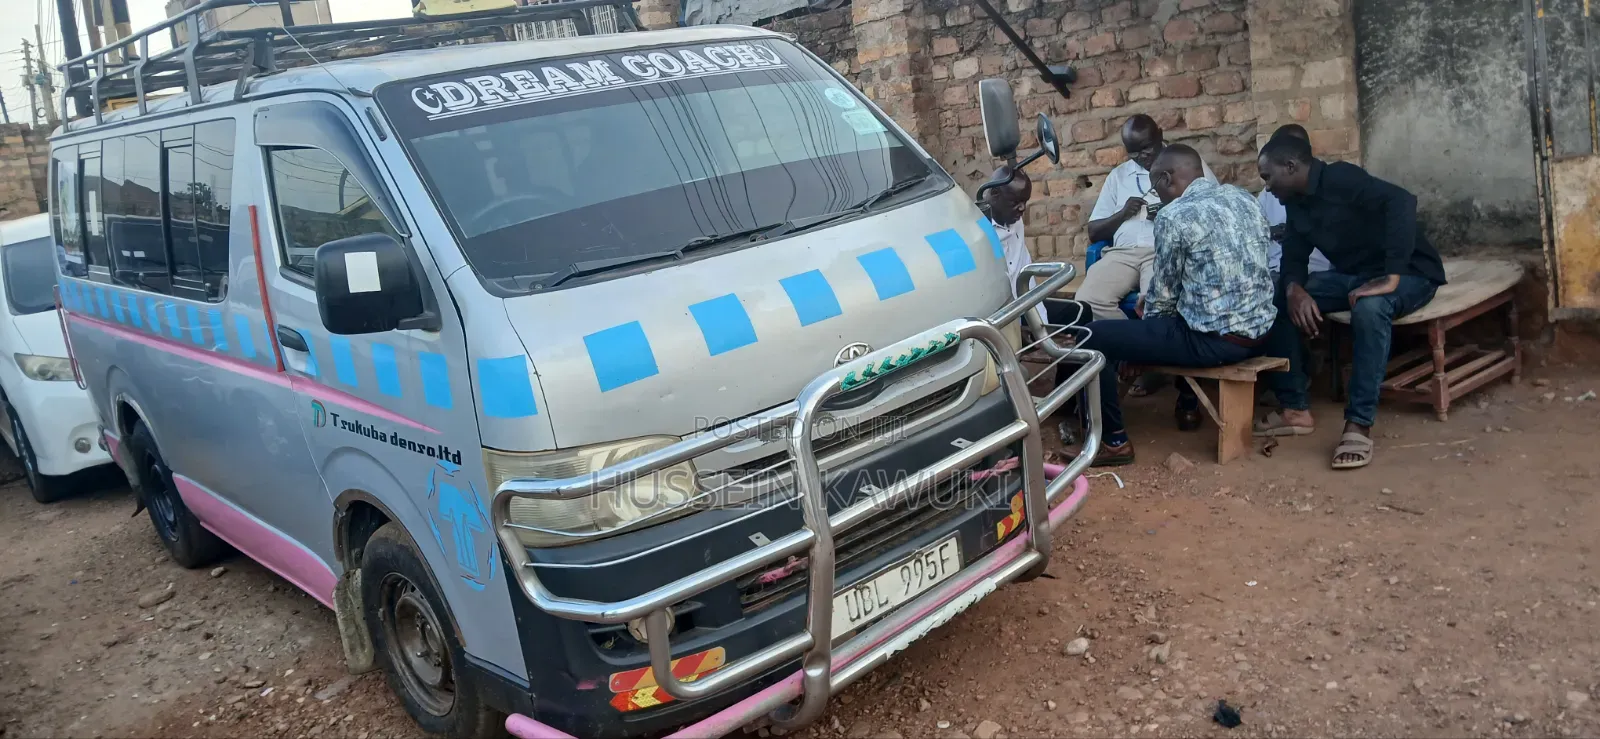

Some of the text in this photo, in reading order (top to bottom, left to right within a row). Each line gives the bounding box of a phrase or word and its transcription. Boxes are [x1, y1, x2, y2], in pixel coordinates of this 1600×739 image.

[429, 44, 772, 111] DREAM COACH
[845, 542, 949, 622] UBL 995F
